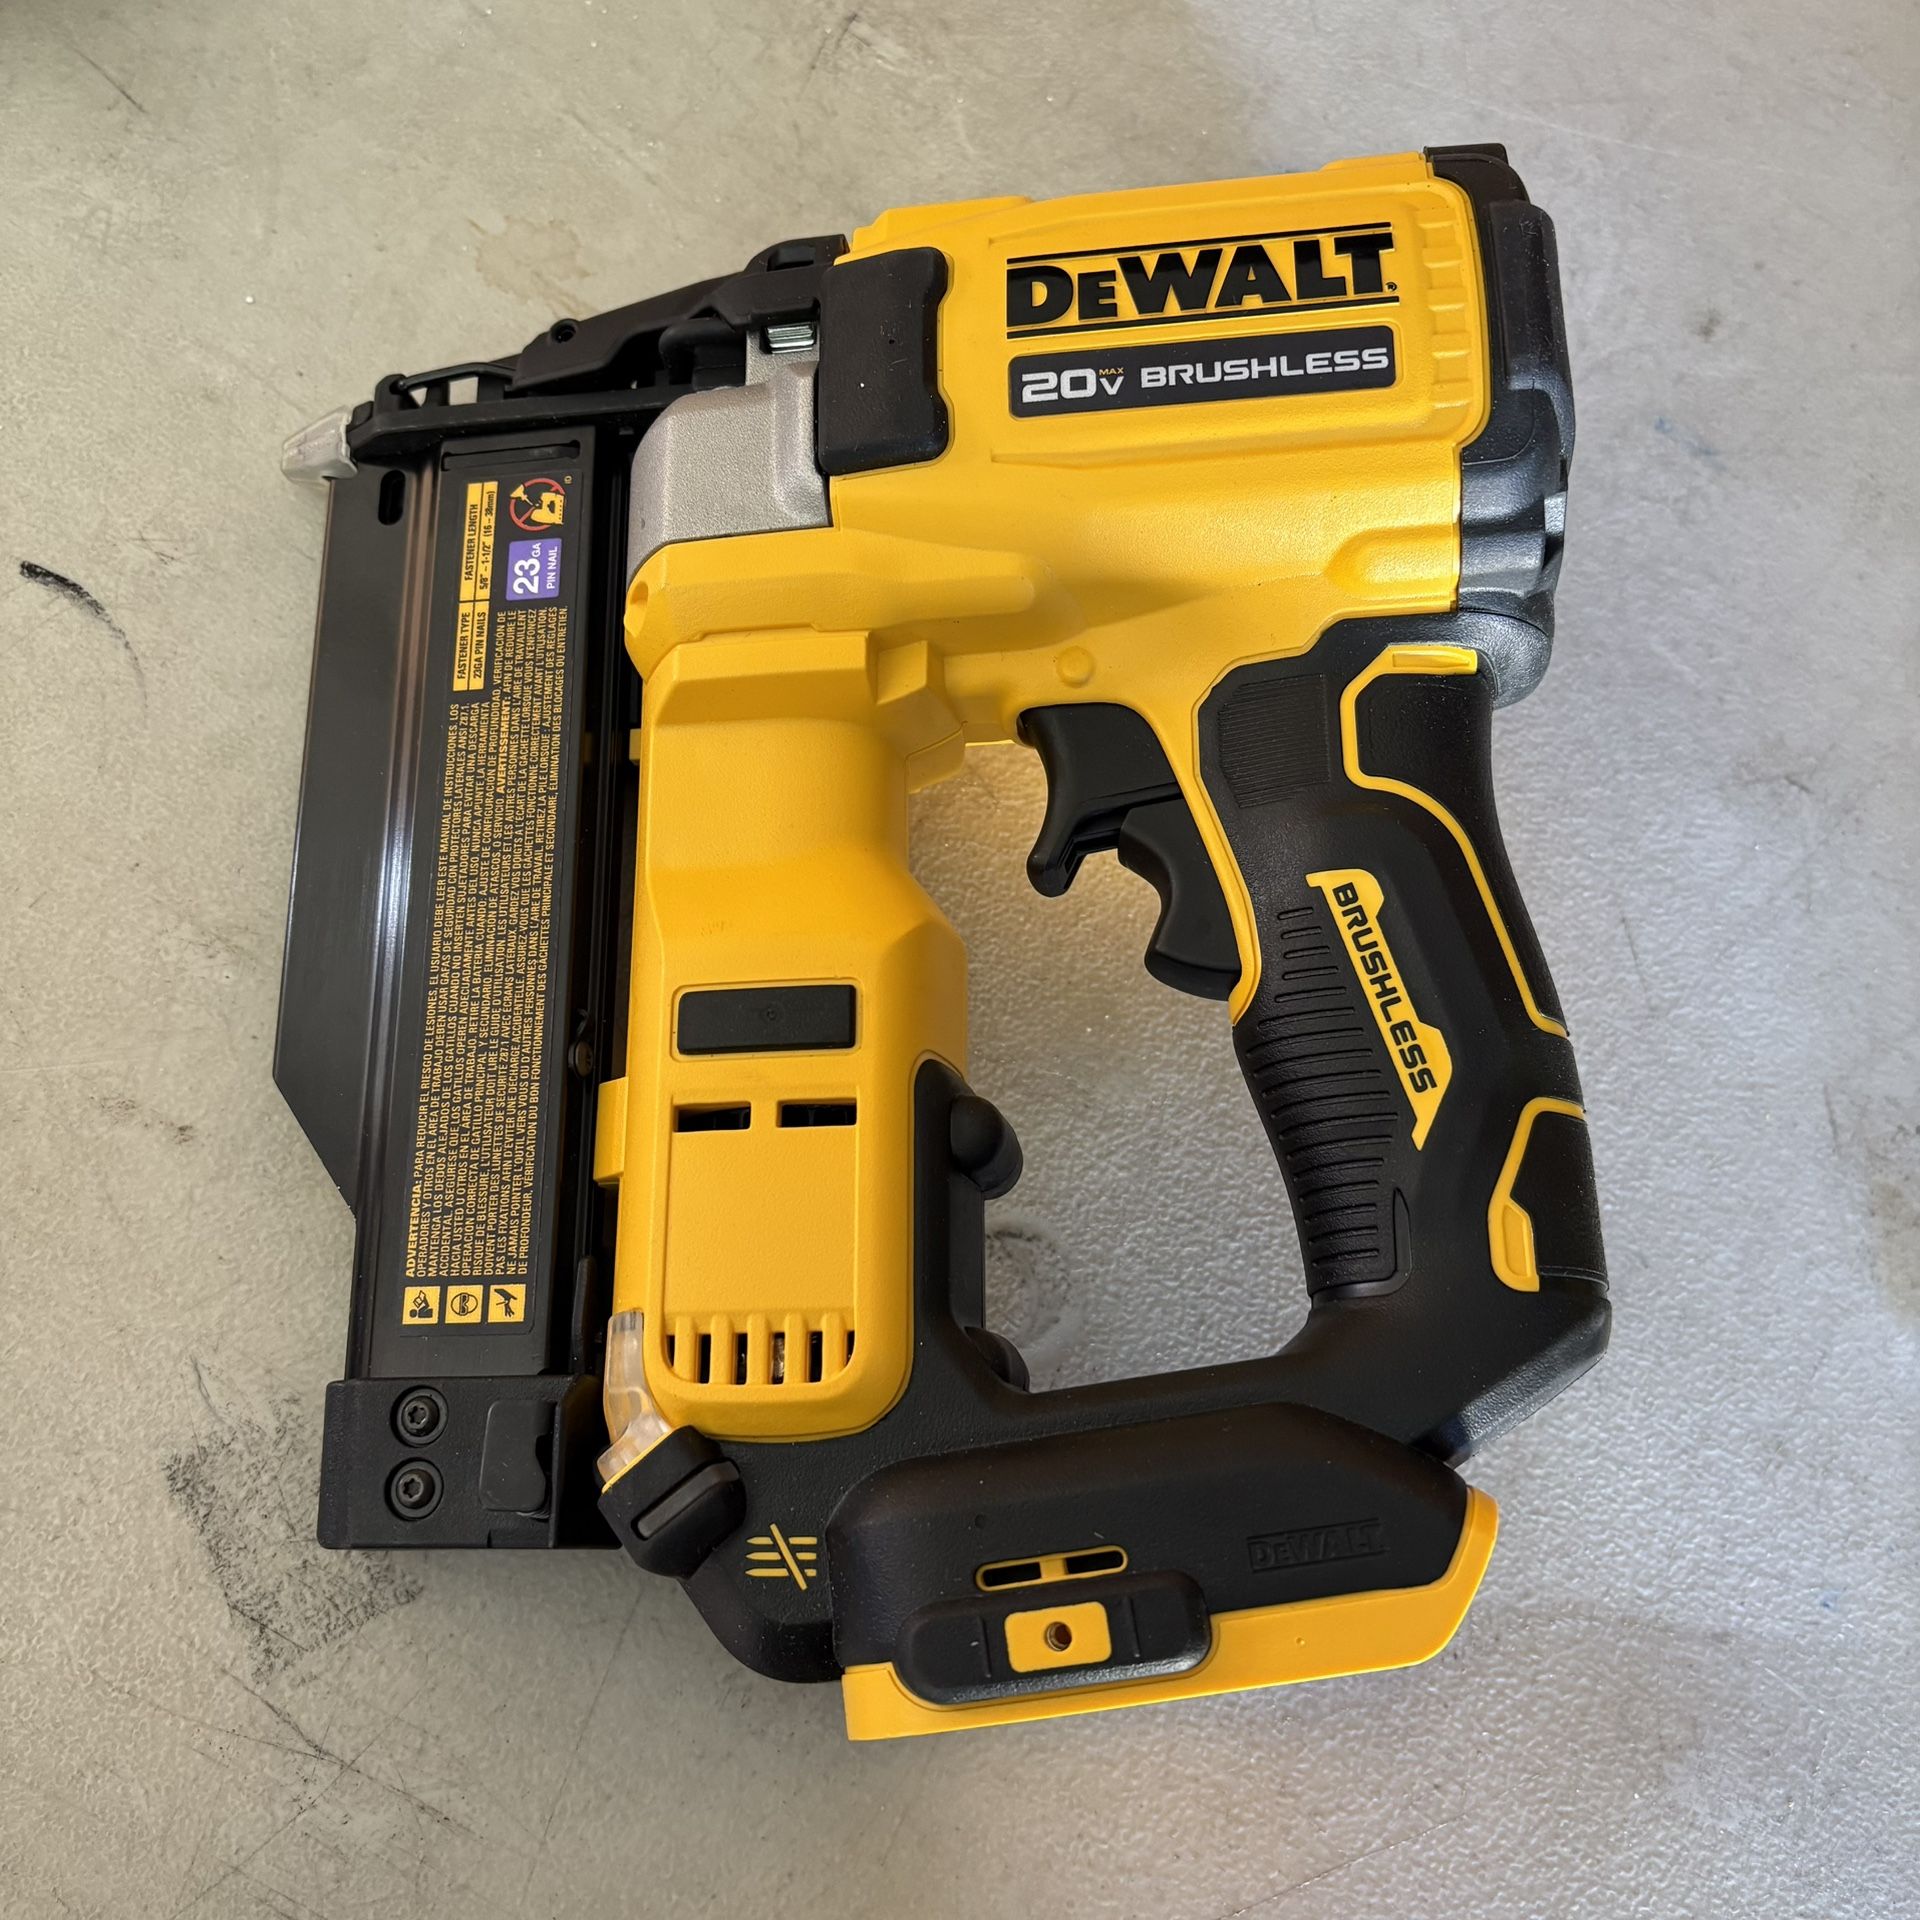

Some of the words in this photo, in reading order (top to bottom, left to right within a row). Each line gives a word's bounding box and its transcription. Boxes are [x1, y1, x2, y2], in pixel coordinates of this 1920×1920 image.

[1099, 366, 1124, 376] MAX
[1141, 347, 1389, 389] BRUSHLESS
[468, 504, 478, 536] LENGTH
[464, 538, 475, 580] FASTENER
[547, 546, 558, 570] NAIL
[546, 572, 556, 590] PIN
[460, 612, 470, 634] TYPE
[476, 612, 486, 638] NAILS
[516, 610, 526, 664] TRAVAILLENT
[457, 636, 468, 679] FASTENER
[474, 640, 484, 654] PIN
[474, 656, 483, 678] 23GA
[504, 673, 512, 693] AFIN
[525, 661, 533, 683] VOUS
[534, 667, 543, 695] AVANT
[522, 685, 532, 722] LORSQUE
[543, 671, 553, 727] AJUSTEMENT
[554, 669, 564, 713] BLOCAGES
[469, 703, 479, 750] DESCARGA
[478, 702, 490, 765] HERRAMIENTA
[511, 708, 520, 732] DANS
[530, 698, 542, 762] CORRECTEMENT
[458, 728, 467, 749] ANSI
[540, 734, 550, 772] LORSQUE
[455, 751, 466, 799] LATERALES
[467, 753, 476, 772] UNA
[508, 734, 519, 786] PERSONNES
[465, 775, 474, 807] EVITAR
[474, 781, 484, 816] APUNTE
[527, 765, 538, 818] FONCTIONNE
[539, 775, 547, 793] PILE
[463, 810, 472, 834] PARA
[506, 788, 515, 822] AUTRES
[440, 813, 451, 852] MANUAL
[450, 801, 462, 862] PROTECTORES
[472, 819, 482, 851] NUNCA
[536, 809, 545, 843] RETIREZ
[438, 855, 448, 877] ESTE
[458, 837, 470, 903] SUJETADORES
[513, 838, 522, 869] DOIGTS
[436, 880, 446, 901] LEER
[449, 865, 457, 884] CON
[469, 878, 477, 894] DEL
[480, 861, 489, 895] AJUSTE
[499, 854, 511, 917] UTILISATEURS
[542, 865, 553, 916] PRINCIPALE
[434, 904, 444, 927] DEBE
[444, 886, 456, 938] SEGURIDAD
[467, 897, 476, 927] ANTES
[510, 891, 519, 924] GARDEZ
[454, 906, 465, 952] INSERTEN
[517, 908, 529, 974] ASSUREZ-VOUS
[529, 931, 538, 956] DANS
[431, 930, 442, 972] USUARIO
[441, 955, 450, 985] GAFAS
[460, 930, 474, 1014] ADECUADAMENTE
[525, 959, 536, 1014] PERSONNES
[1332, 881, 1437, 1093] BRUSHLESS
[439, 987, 448, 1012] USAR
[450, 972, 460, 1013] CUANDO
[436, 1015, 446, 1046] DEBEN
[469, 1001, 479, 1033] RETIRE
[491, 1008, 500, 1036] GUIDE
[502, 1015, 511, 1038] AVEC
[446, 1016, 456, 1062] GATILLOS
[457, 1017, 467, 1054] OPEREN
[532, 993, 545, 1079] FONCTIONNEMENT
[421, 1054, 432, 1089] RIESGO
[432, 1049, 443, 1093] TRABAJO
[475, 1052, 486, 1102] PRINCIPAL
[488, 1051, 497, 1070] LIRE
[453, 1058, 464, 1103] GATILLOS
[487, 1074, 496, 1095] DOIT
[519, 1082, 528, 1107] VOUS
[530, 1083, 540, 1103] BON
[417, 1105, 428, 1147] REDUCIR
[438, 1102, 450, 1153] ALEJADOS
[472, 1105, 482, 1144] GATILLO
[517, 1110, 526, 1134] VERS
[414, 1150, 424, 1177] PARA
[492, 1125, 503, 1171] LUNETTES
[424, 1168, 434, 1200] OTROS
[436, 1157, 446, 1191] DEDOS
[457, 1162, 467, 1195] OTROS
[503, 1160, 512, 1181] AFIN
[467, 1163, 478, 1214] CORRECTA
[511, 1175, 522, 1216] POINTER
[454, 1208, 464, 1241] USTED
[488, 1194, 498, 1230] PORTER
[499, 1184, 510, 1233] FIXATIONS
[418, 1212, 430, 1277] OPERADORES
[429, 1216, 441, 1276] MANTENGA
[485, 1234, 495, 1275] DOIVENT
[508, 1219, 519, 1258] JAMAIS
[451, 1244, 461, 1276] HACIA
[474, 1240, 484, 1275] RISQUE
